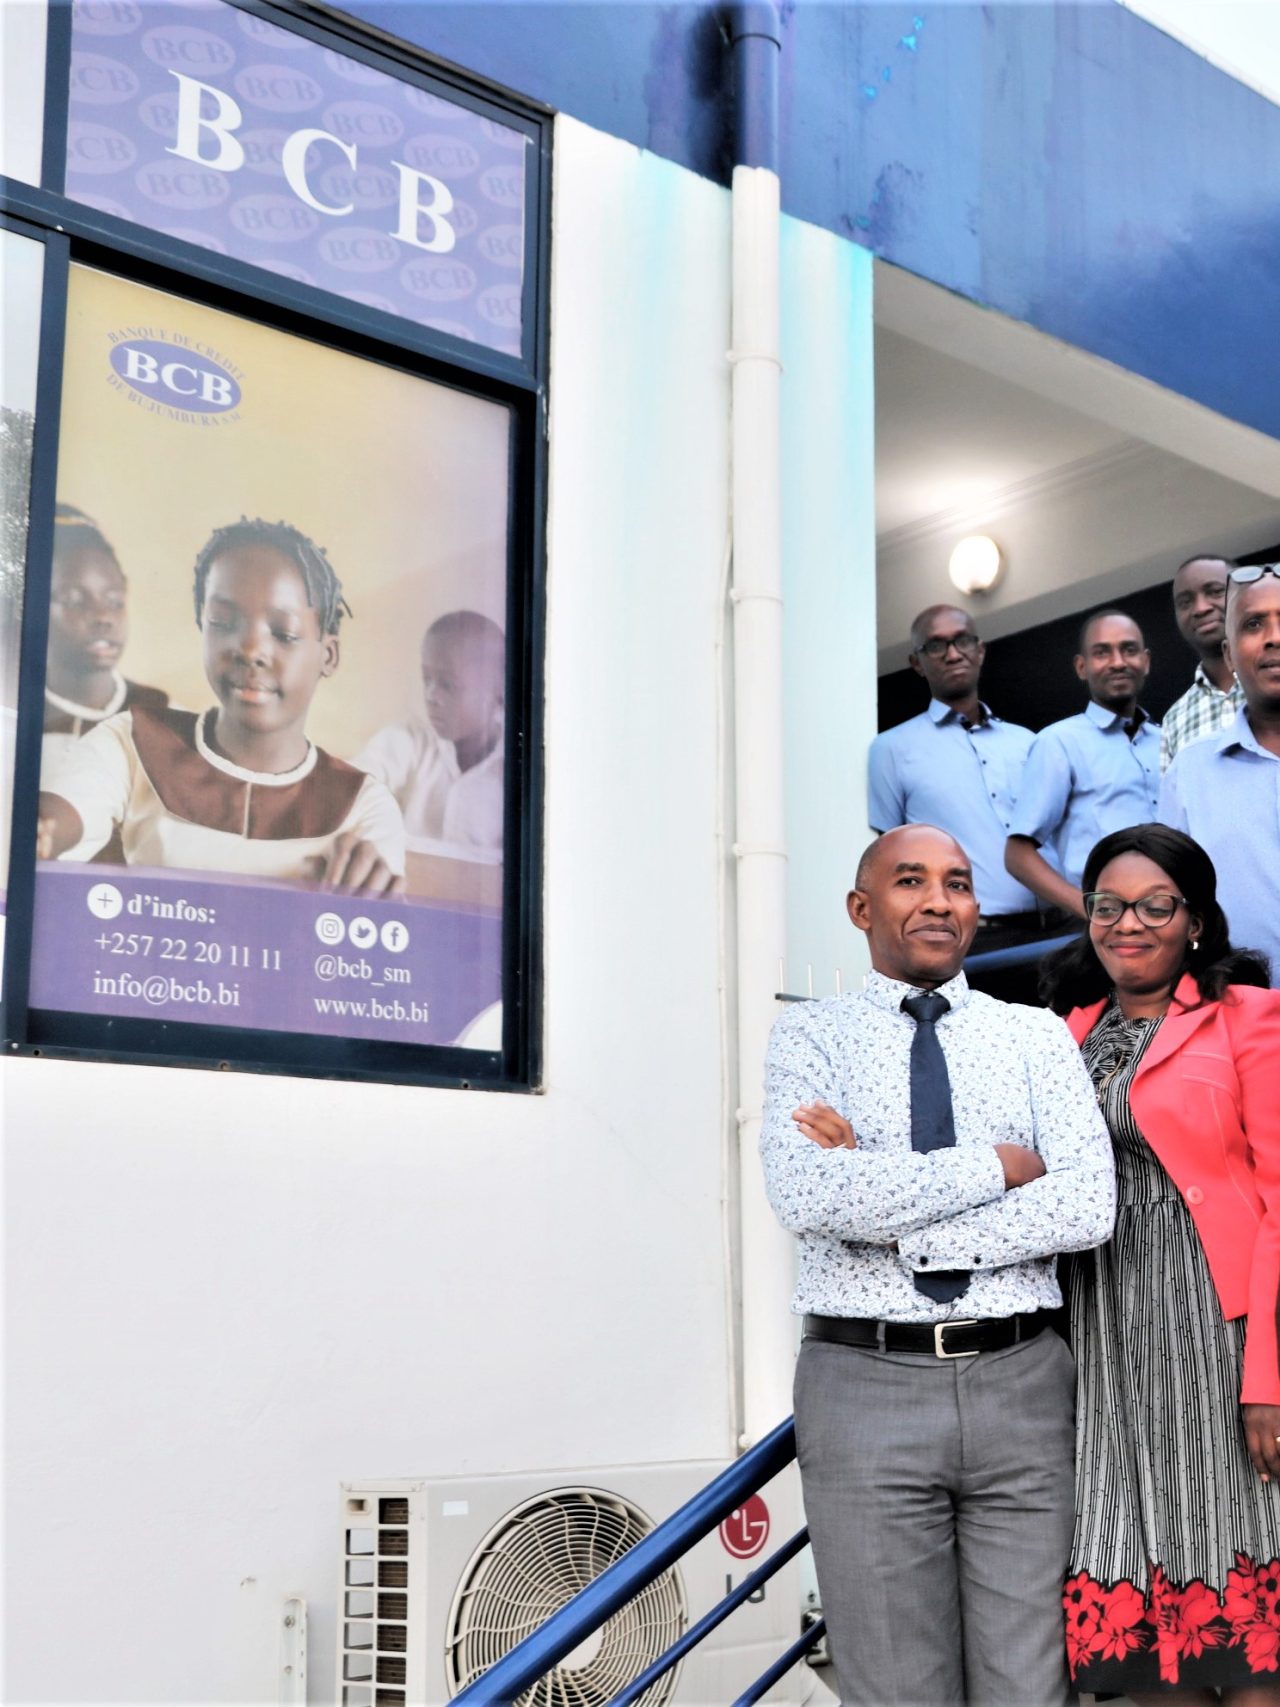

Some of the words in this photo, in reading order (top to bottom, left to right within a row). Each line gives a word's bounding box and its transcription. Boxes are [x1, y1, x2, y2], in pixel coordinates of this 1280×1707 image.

[71, 66, 134, 93] CB
[68, 136, 130, 161] CB
[107, 327, 167, 343] BANQUE
[173, 332, 193, 346] DE
[122, 347, 233, 406] BCB
[94, 932, 153, 956] +257
[160, 938, 187, 960] 22
[194, 941, 221, 964] 20
[230, 945, 249, 967] 11
[262, 948, 281, 970] 11
[315, 954, 411, 986] @bcb_sm
[93, 970, 240, 1006] info@bcb.bi
[314, 997, 429, 1023] www.bcb.bi
